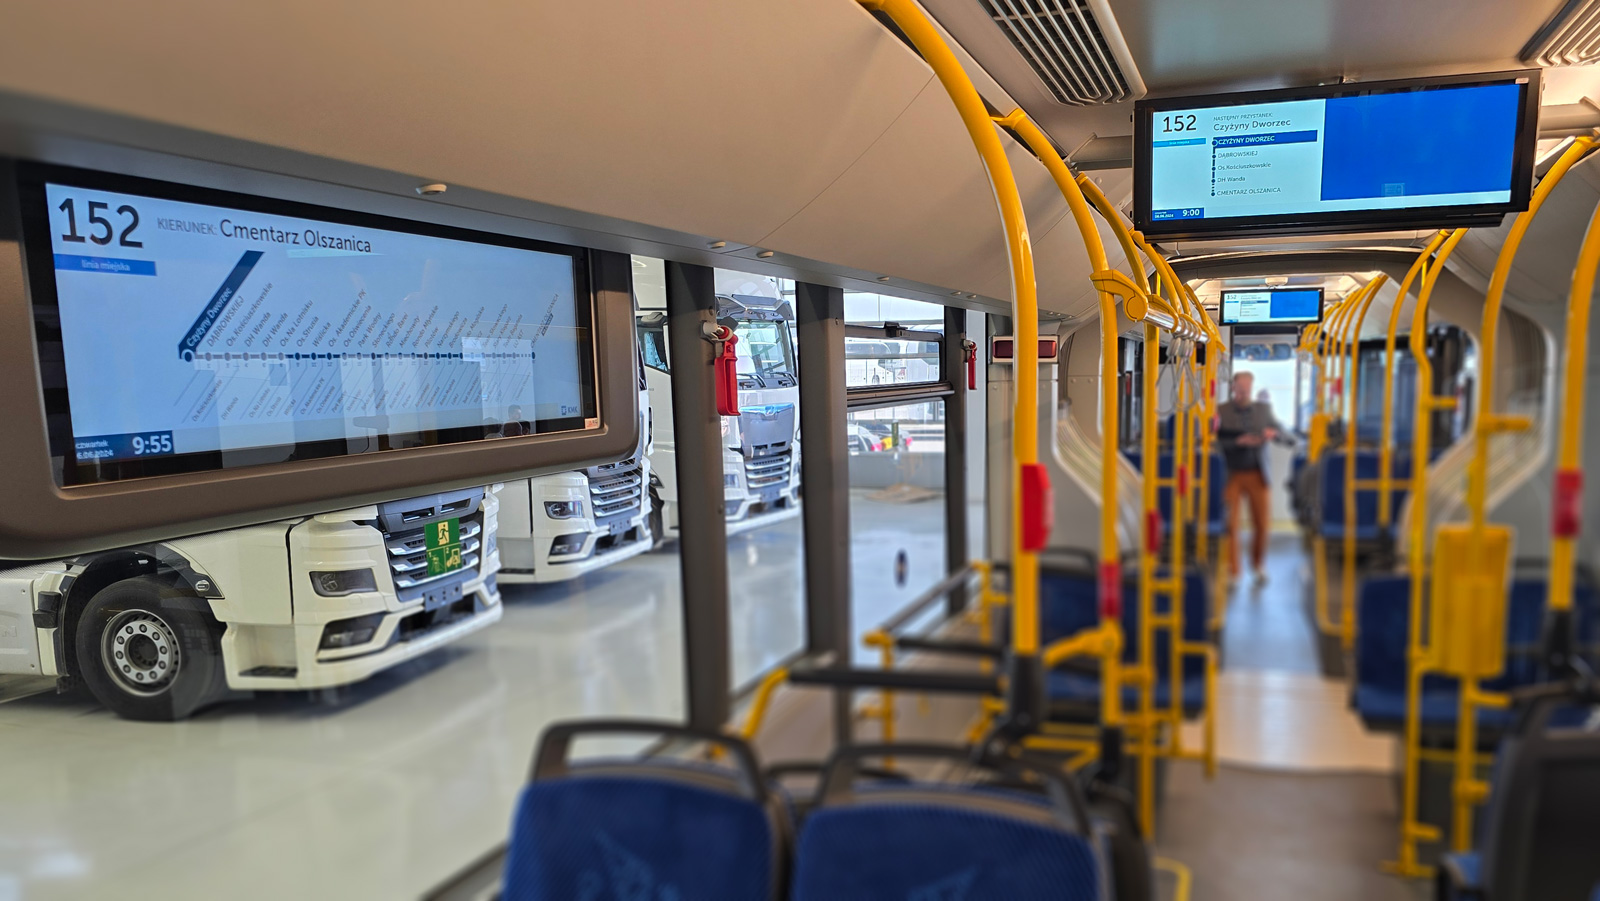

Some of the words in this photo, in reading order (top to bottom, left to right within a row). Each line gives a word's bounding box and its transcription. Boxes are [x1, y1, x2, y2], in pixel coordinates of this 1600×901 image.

[1162, 114, 1197, 133] 152
[1213, 122, 1250, 132] Czyżyny
[1252, 119, 1291, 128] Dworzec
[1245, 135, 1275, 143] DWORZEC
[58, 197, 144, 249] 152
[1182, 209, 1200, 217] 9:00
[156, 217, 217, 236] KIERUNEK:
[219, 218, 299, 245] Cmentarz
[304, 228, 372, 254] Olszanica
[81, 259, 100, 269] linia
[100, 261, 131, 272] miejska
[186, 317, 213, 347] Czyżyny
[206, 286, 233, 319] Dworzec
[294, 299, 314, 328] Lotnisku
[244, 333, 256, 347] DH
[252, 311, 271, 335] Wanda
[262, 333, 273, 347] DH
[270, 312, 289, 335] Wanda
[358, 333, 369, 348] Park
[366, 312, 382, 334] Wodny
[132, 434, 172, 455] 9:55
